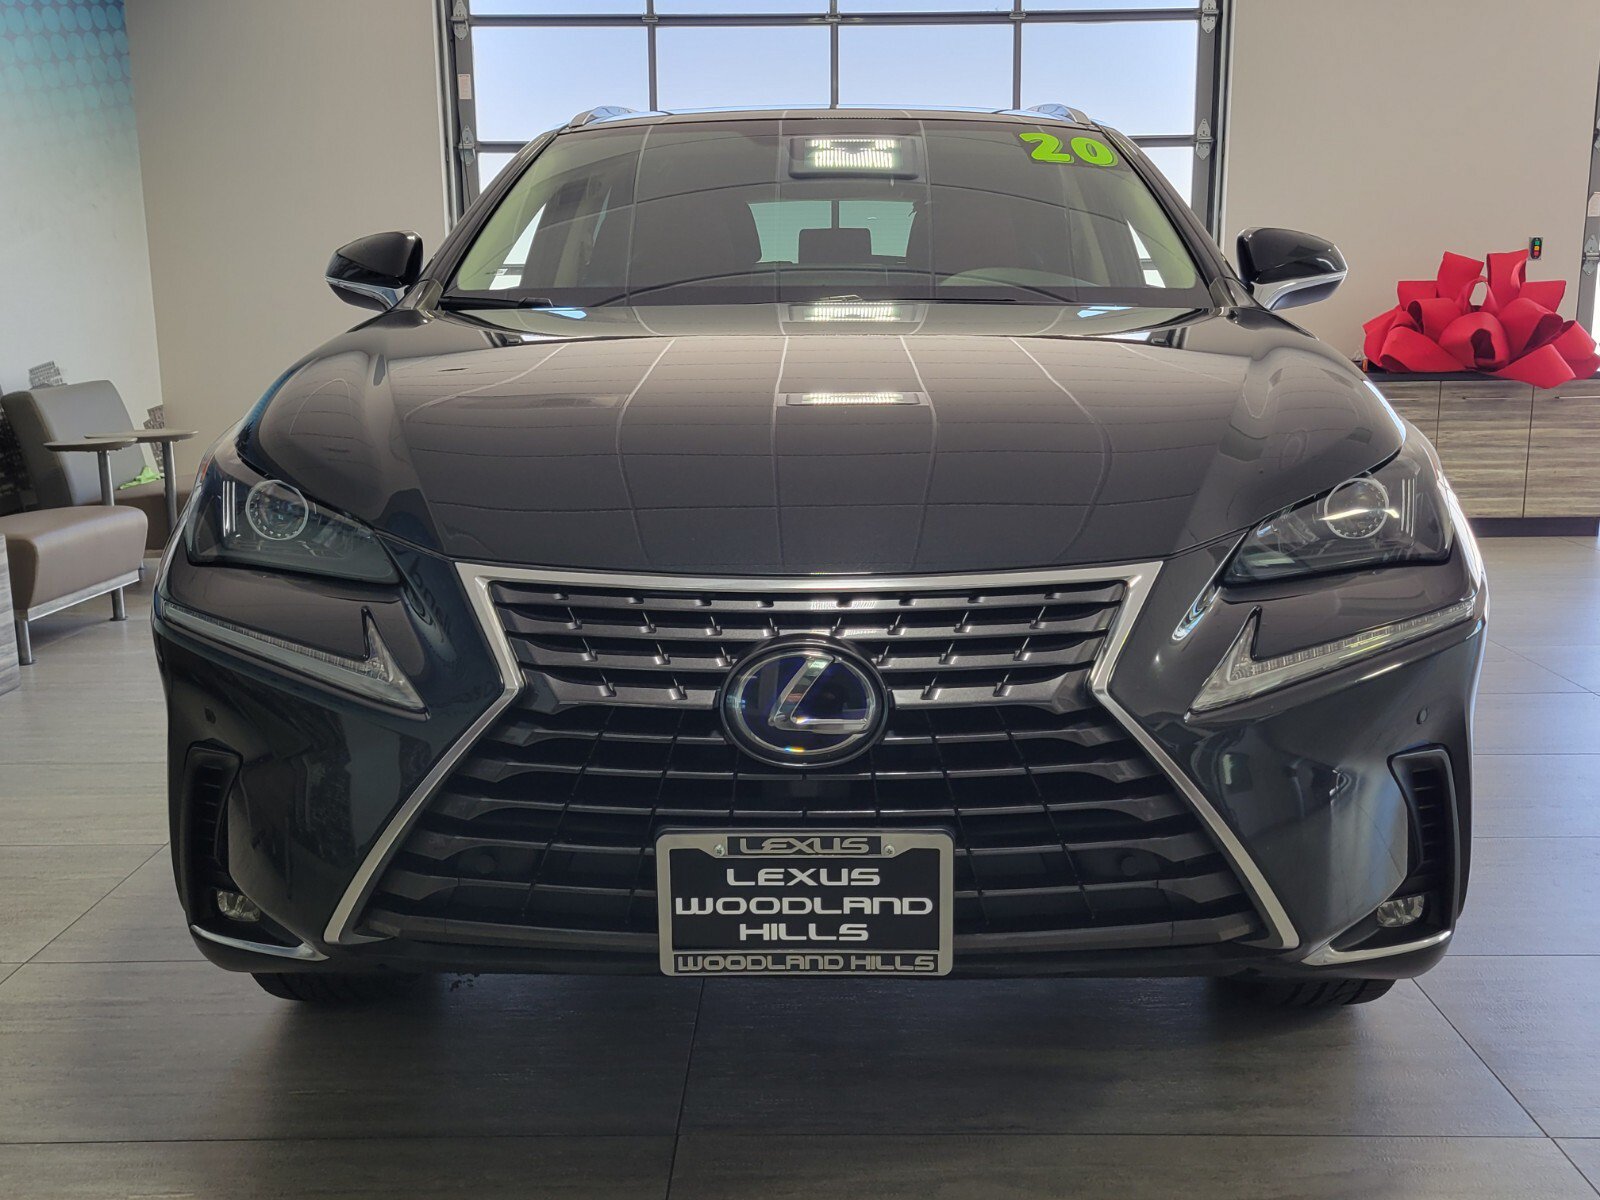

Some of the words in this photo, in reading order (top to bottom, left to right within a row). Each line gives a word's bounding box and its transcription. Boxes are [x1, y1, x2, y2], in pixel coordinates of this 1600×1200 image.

[1019, 132, 1119, 167] 20
[739, 837, 870, 854] LEXUS
[726, 868, 881, 886] LEXUS
[675, 897, 934, 915] WOODLAND
[739, 923, 869, 941] HILLS
[677, 954, 844, 971] WOODLAND
[850, 954, 935, 971] HILLS
